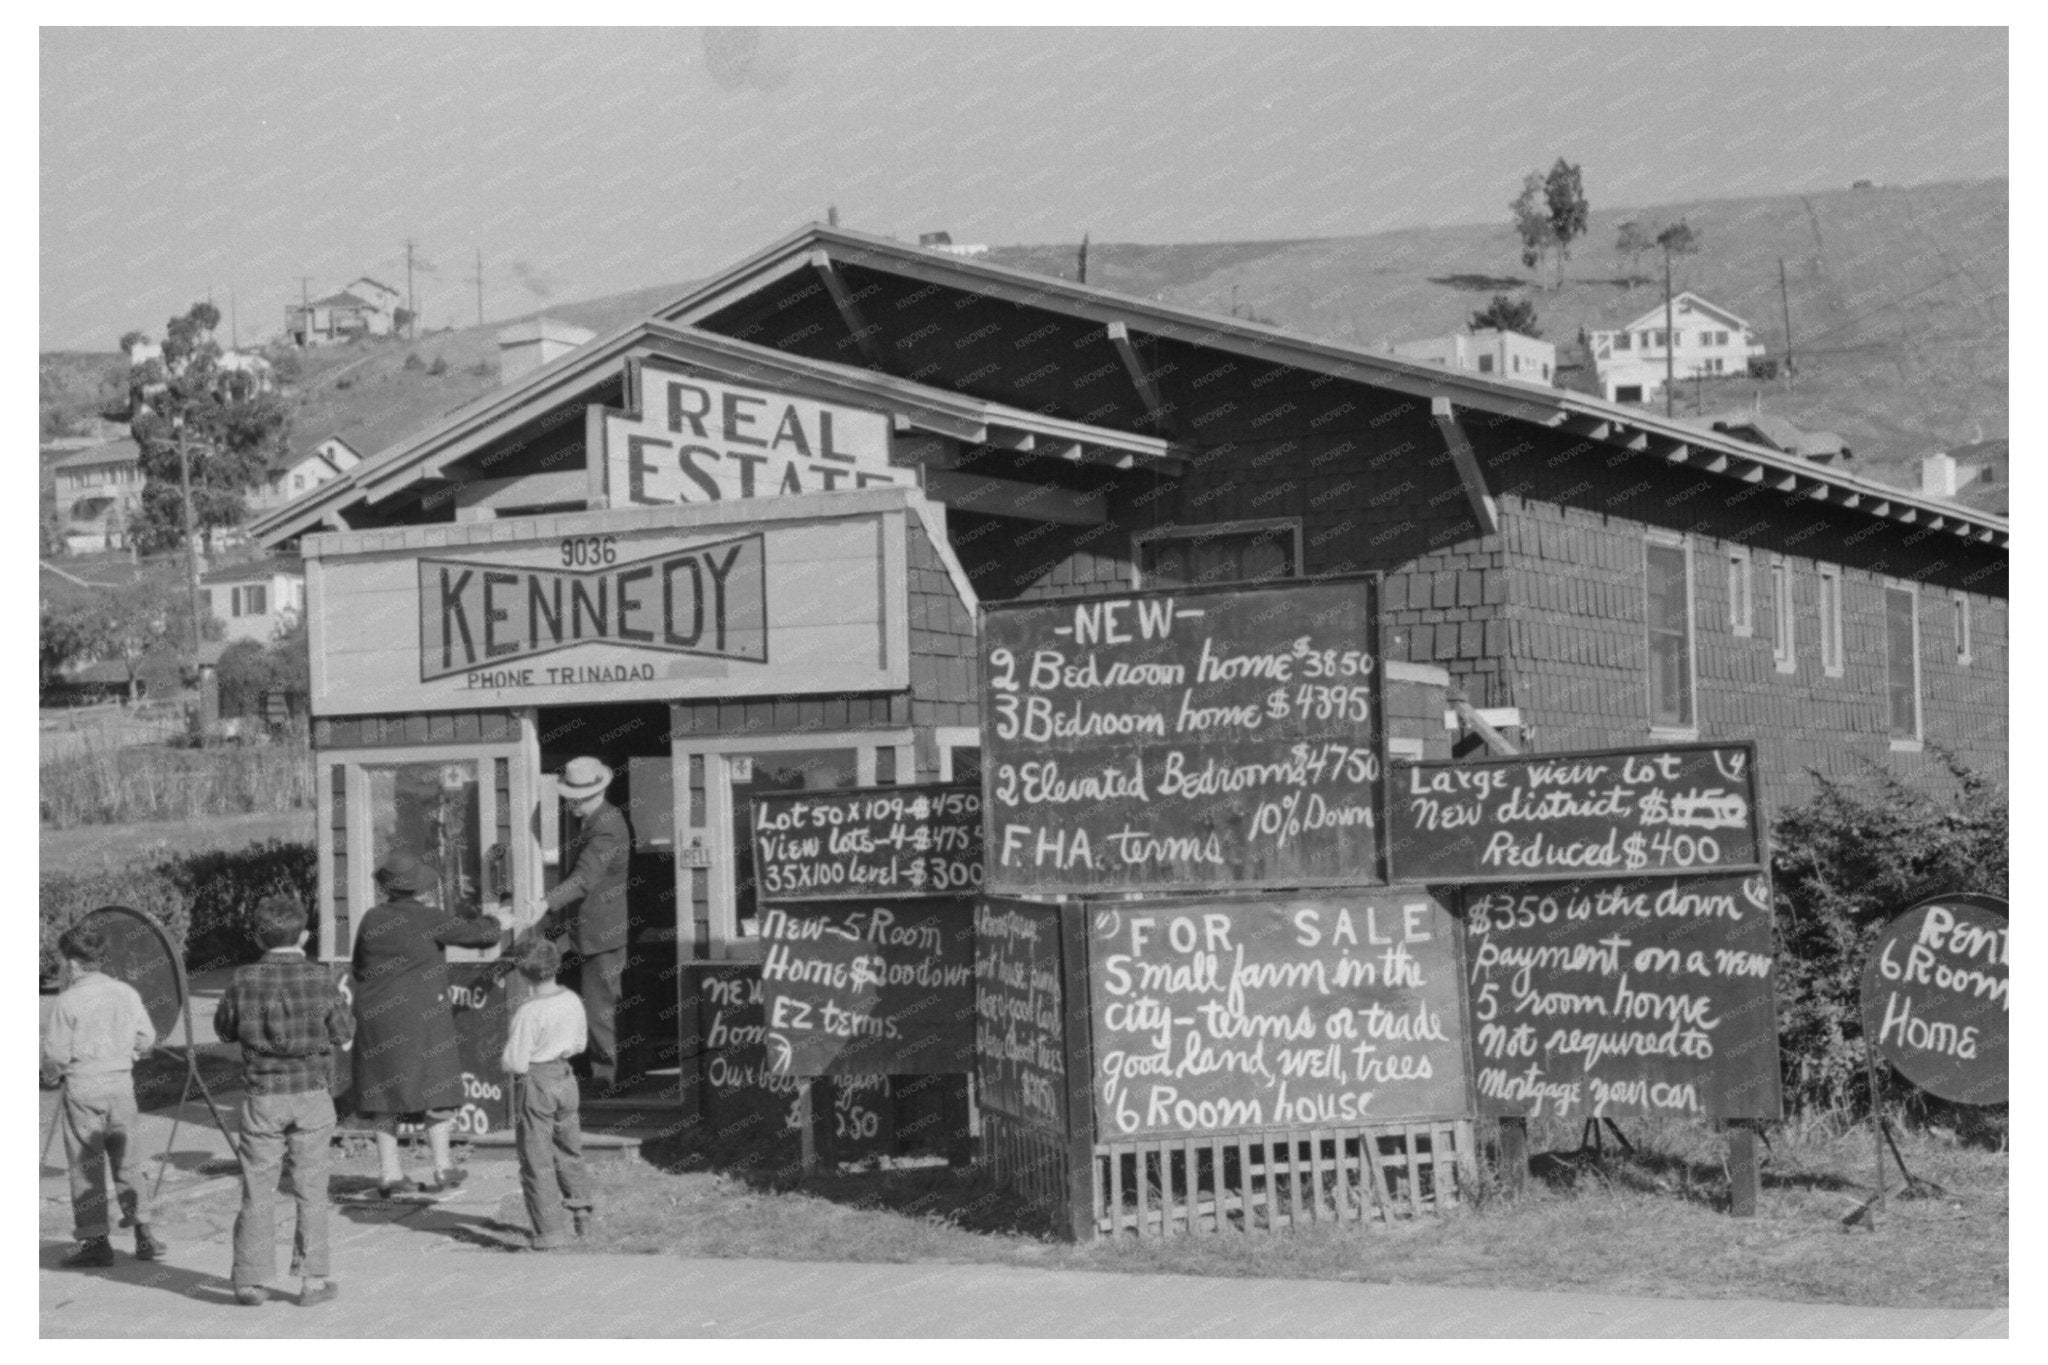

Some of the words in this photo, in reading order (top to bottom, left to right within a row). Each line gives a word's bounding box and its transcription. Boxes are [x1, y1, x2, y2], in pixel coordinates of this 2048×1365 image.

[668, 380, 856, 464] REAL
[561, 537, 617, 567] 9036
[440, 545, 743, 669] KENNEDY
[468, 669, 536, 689] PHONE
[545, 663, 655, 686] TRINADAD
[990, 648, 1019, 691] 2
[1029, 651, 1184, 690] Bedroom
[1197, 638, 1292, 682] home
[996, 694, 1020, 739] 3
[1024, 697, 1165, 741] Bedroom
[1177, 688, 1262, 732] home
[997, 764, 1020, 806] 2
[1020, 758, 1149, 802] Elevated
[1410, 765, 1507, 799] Large
[1526, 760, 1607, 789] view
[757, 802, 808, 829] Lot
[1249, 791, 1299, 848] 10%
[1303, 794, 1373, 832] Down
[760, 834, 820, 862] View
[1107, 824, 1223, 863] terms
[1482, 827, 1622, 867] Reduced
[1624, 829, 1720, 870] $400
[868, 908, 942, 955] Room
[1130, 913, 1232, 957] FOR
[1295, 904, 1432, 946] SALE
[1468, 895, 1559, 935] $350
[1567, 888, 1590, 921] is
[1595, 886, 1648, 918] the
[1656, 879, 1744, 921] down
[762, 944, 846, 988] Home
[1105, 951, 1227, 995] Small
[1228, 943, 1330, 1018] farm
[1332, 948, 1376, 987] in
[1378, 939, 1427, 987] the
[1471, 933, 1631, 998] payment
[1634, 947, 1681, 974] on
[1686, 948, 1711, 976] a
[1714, 948, 1772, 978] new
[1880, 938, 1901, 980] 6
[771, 995, 813, 1029] EZ
[1325, 1007, 1358, 1039] or
[1358, 998, 1449, 1042] trade
[1476, 984, 1499, 1021] 5
[1514, 990, 1607, 1015] room
[1614, 972, 1721, 1029] home
[1880, 991, 1979, 1059] Home
[1103, 1047, 1174, 1105] good
[1175, 1030, 1277, 1088] land,
[1352, 1040, 1433, 1082] trees
[1478, 1023, 1538, 1058] Not
[1544, 1020, 1682, 1072] required
[1682, 1031, 1712, 1059] to
[1116, 1088, 1139, 1133] 6
[1147, 1085, 1262, 1129] Room
[1273, 1081, 1374, 1122] house
[1477, 1062, 1581, 1117] Mortgage
